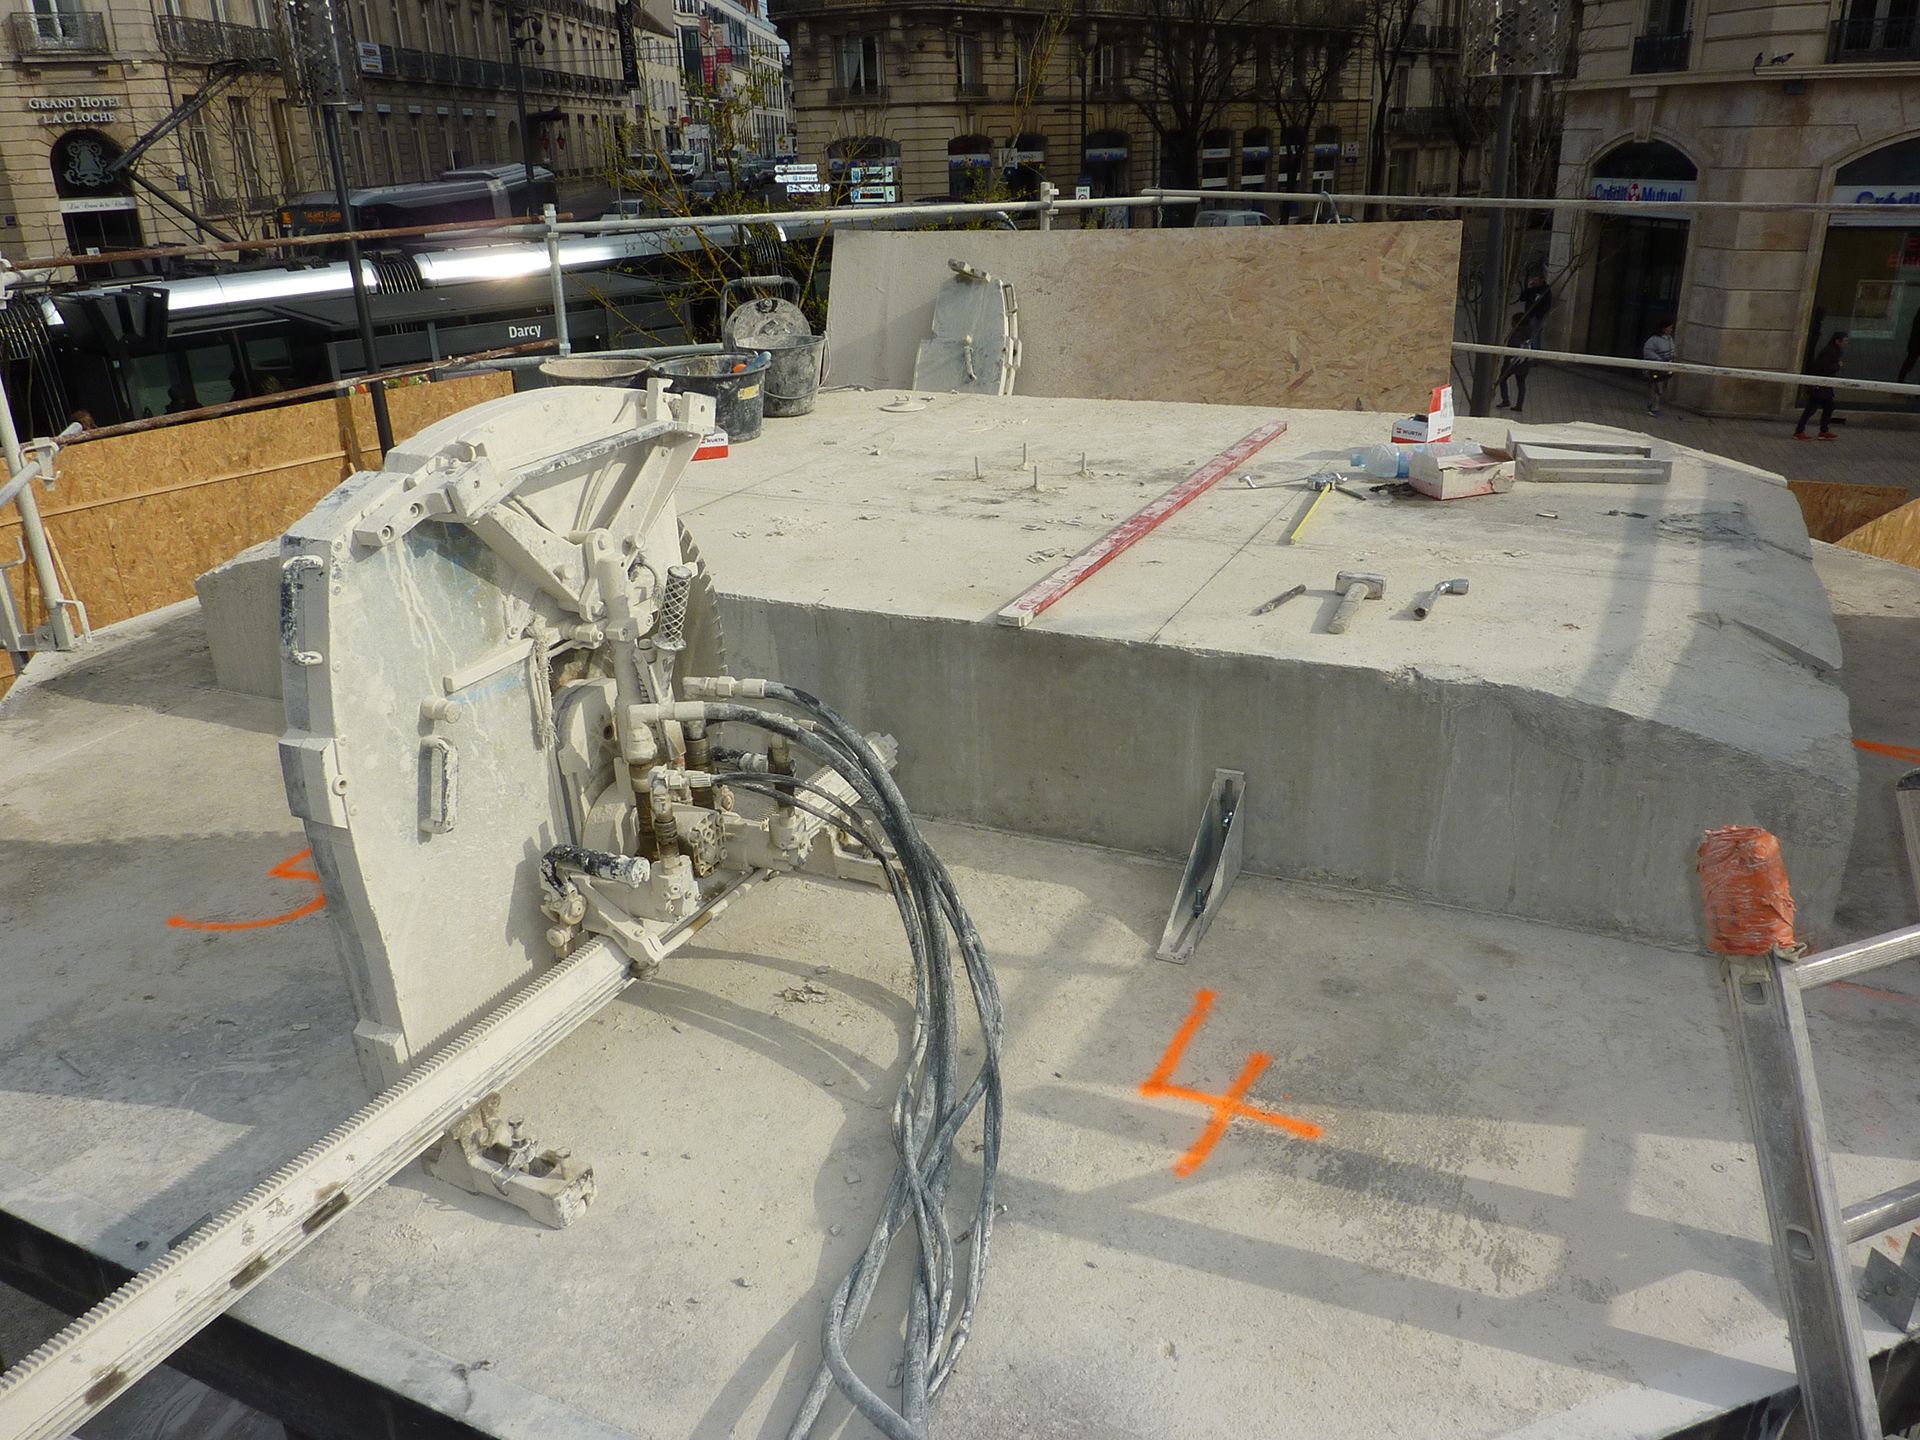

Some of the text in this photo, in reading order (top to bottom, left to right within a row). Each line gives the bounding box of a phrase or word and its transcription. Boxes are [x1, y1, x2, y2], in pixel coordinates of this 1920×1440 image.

[28, 96, 121, 109] GRAND HOTEL
[44, 111, 115, 124] LA CLOCHE
[1641, 187, 1683, 202] Mutuel
[508, 324, 541, 339] Darcy
[1139, 988, 1325, 1179] 4
